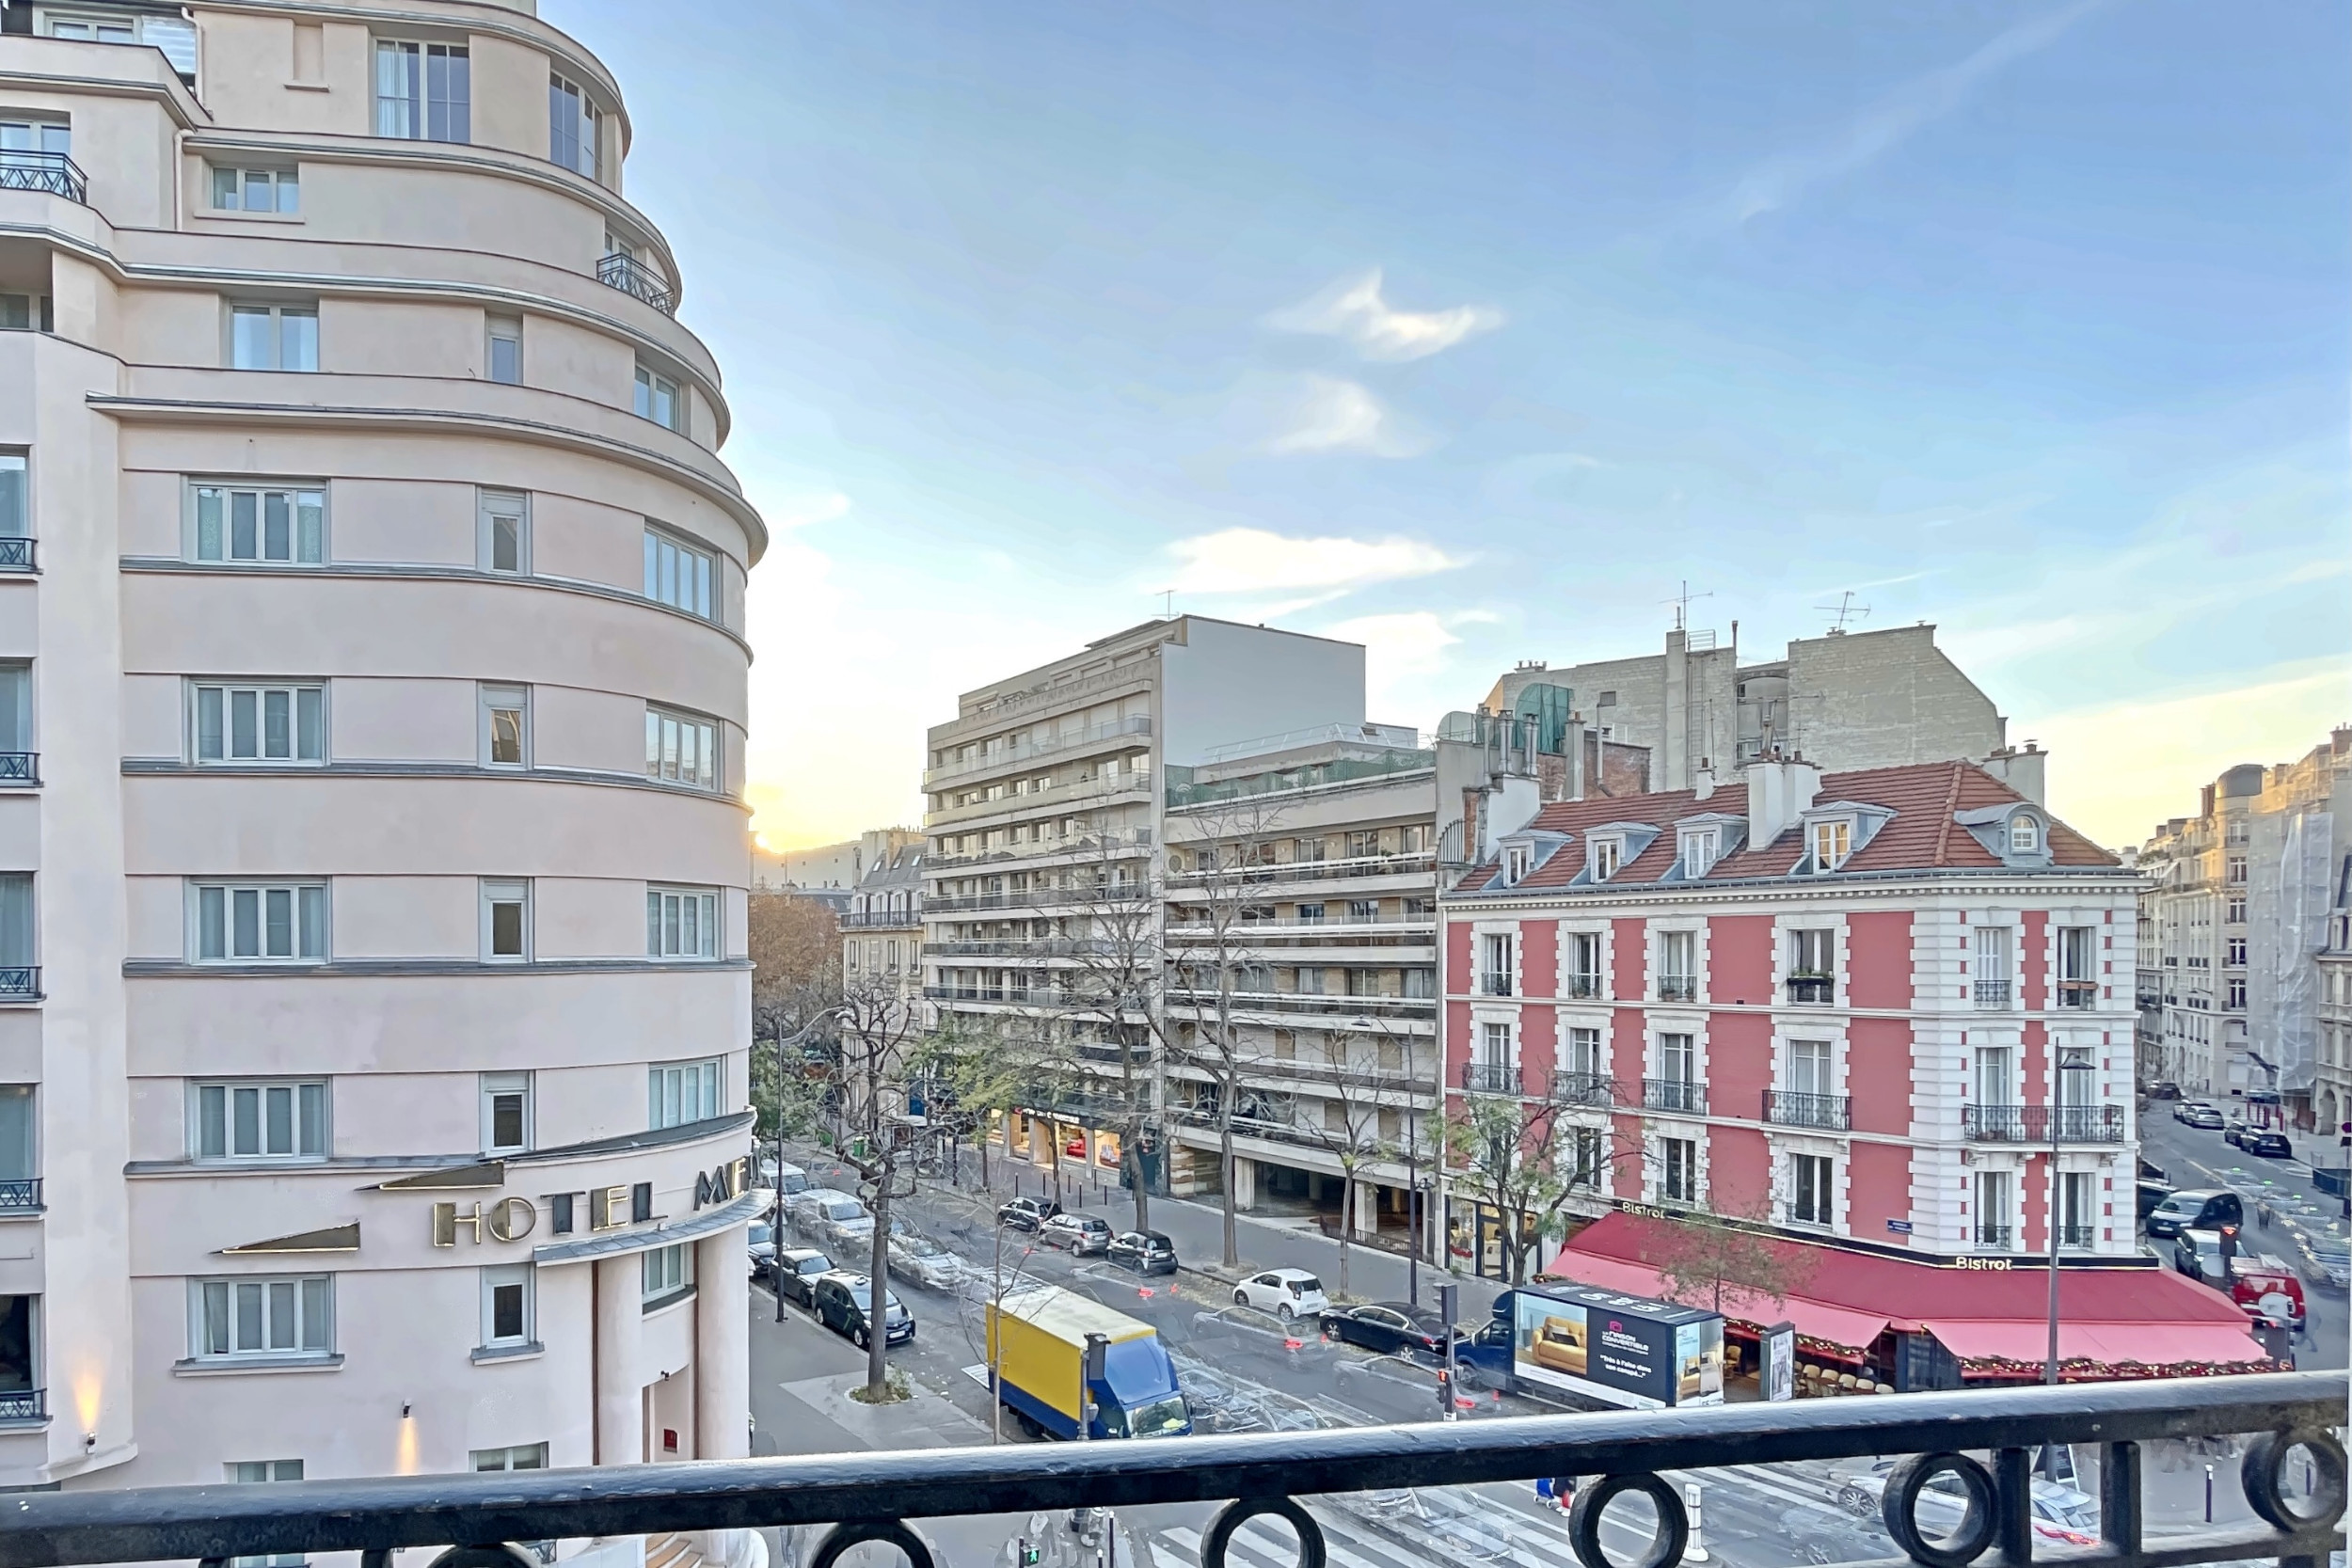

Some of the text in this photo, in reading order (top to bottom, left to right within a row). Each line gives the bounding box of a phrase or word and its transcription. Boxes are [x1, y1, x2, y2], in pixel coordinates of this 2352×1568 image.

[433, 1181, 669, 1247] HOTEL
[1622, 1201, 1665, 1219] Bistrot
[1956, 1256, 2012, 1271] Bistrot
[1602, 1336, 1649, 1352] CONVERTIBLE
